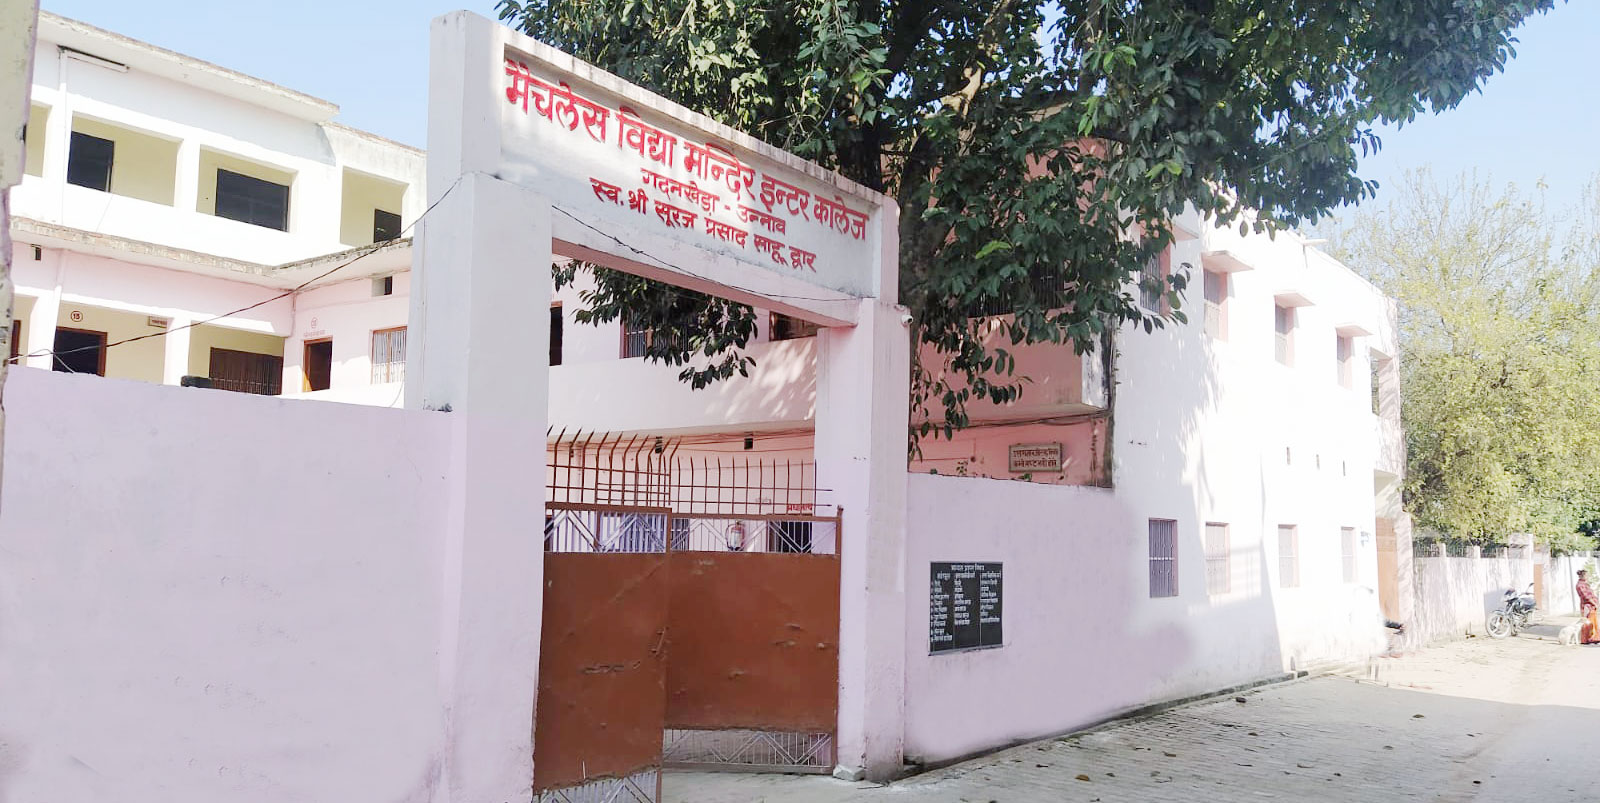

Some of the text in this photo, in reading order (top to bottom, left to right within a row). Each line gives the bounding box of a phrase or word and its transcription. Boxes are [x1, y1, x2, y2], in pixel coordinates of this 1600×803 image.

[505, 58, 869, 240] मैचलेस विद्या मन्दिर इन्टर कालेज
[654, 199, 698, 229] सूरज
[704, 217, 749, 249] प्रसाद
[754, 234, 788, 265] साहू
[789, 246, 817, 273] द्वार
[737, 204, 786, 234] उन्नाव
